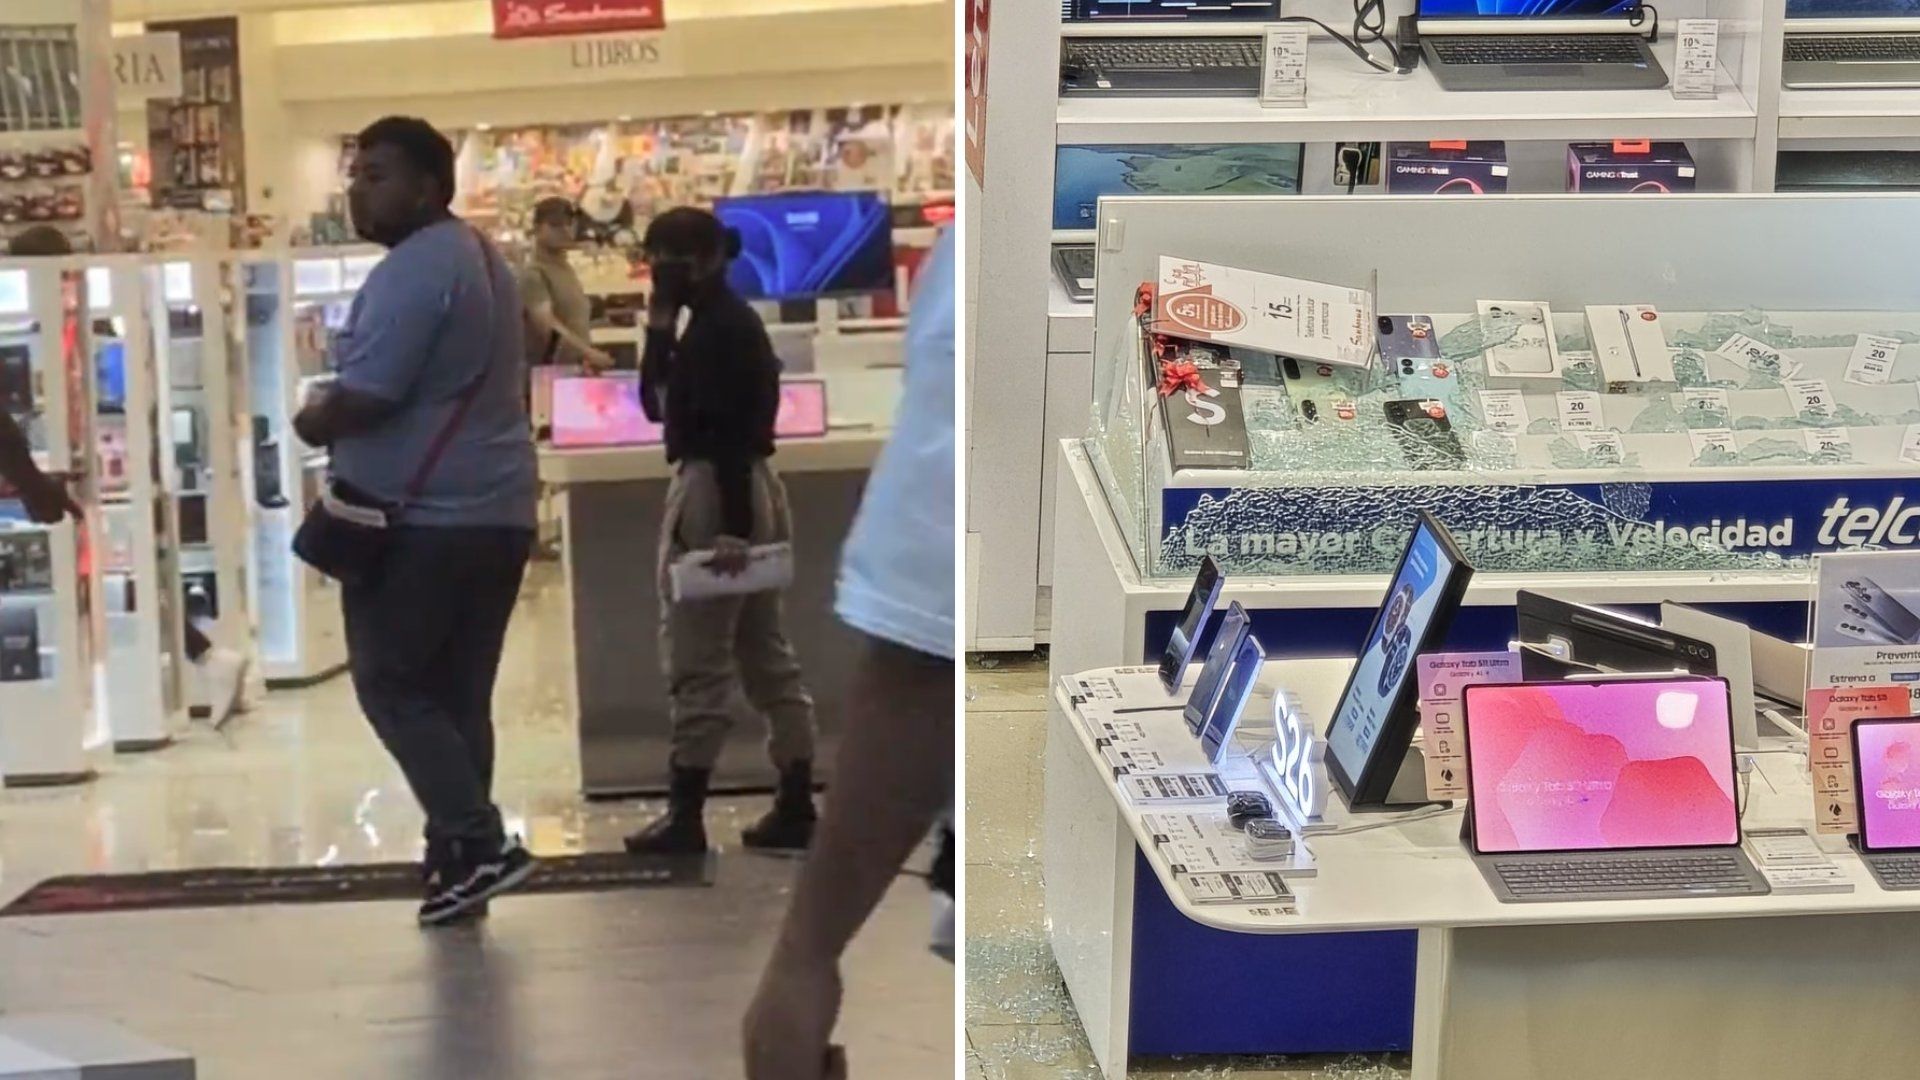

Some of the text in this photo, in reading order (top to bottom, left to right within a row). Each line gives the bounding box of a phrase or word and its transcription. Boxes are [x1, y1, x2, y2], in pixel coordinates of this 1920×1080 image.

[571, 39, 659, 68] LIBROS
[1586, 171, 1615, 179] GAMING
[1872, 349, 1886, 359] 20
[1806, 396, 1821, 405] 20
[1571, 402, 1584, 411] 20
[1817, 497, 1920, 546] telc
[1185, 524, 1229, 555] La
[1371, 523, 1562, 554] Coertura
[1607, 518, 1794, 548] Velocidad
[1429, 661, 1460, 669] Galaxy
[1829, 674, 1876, 683] Estrena a
[1828, 695, 1858, 703] Galaxy
[1271, 690, 1313, 817] S26
